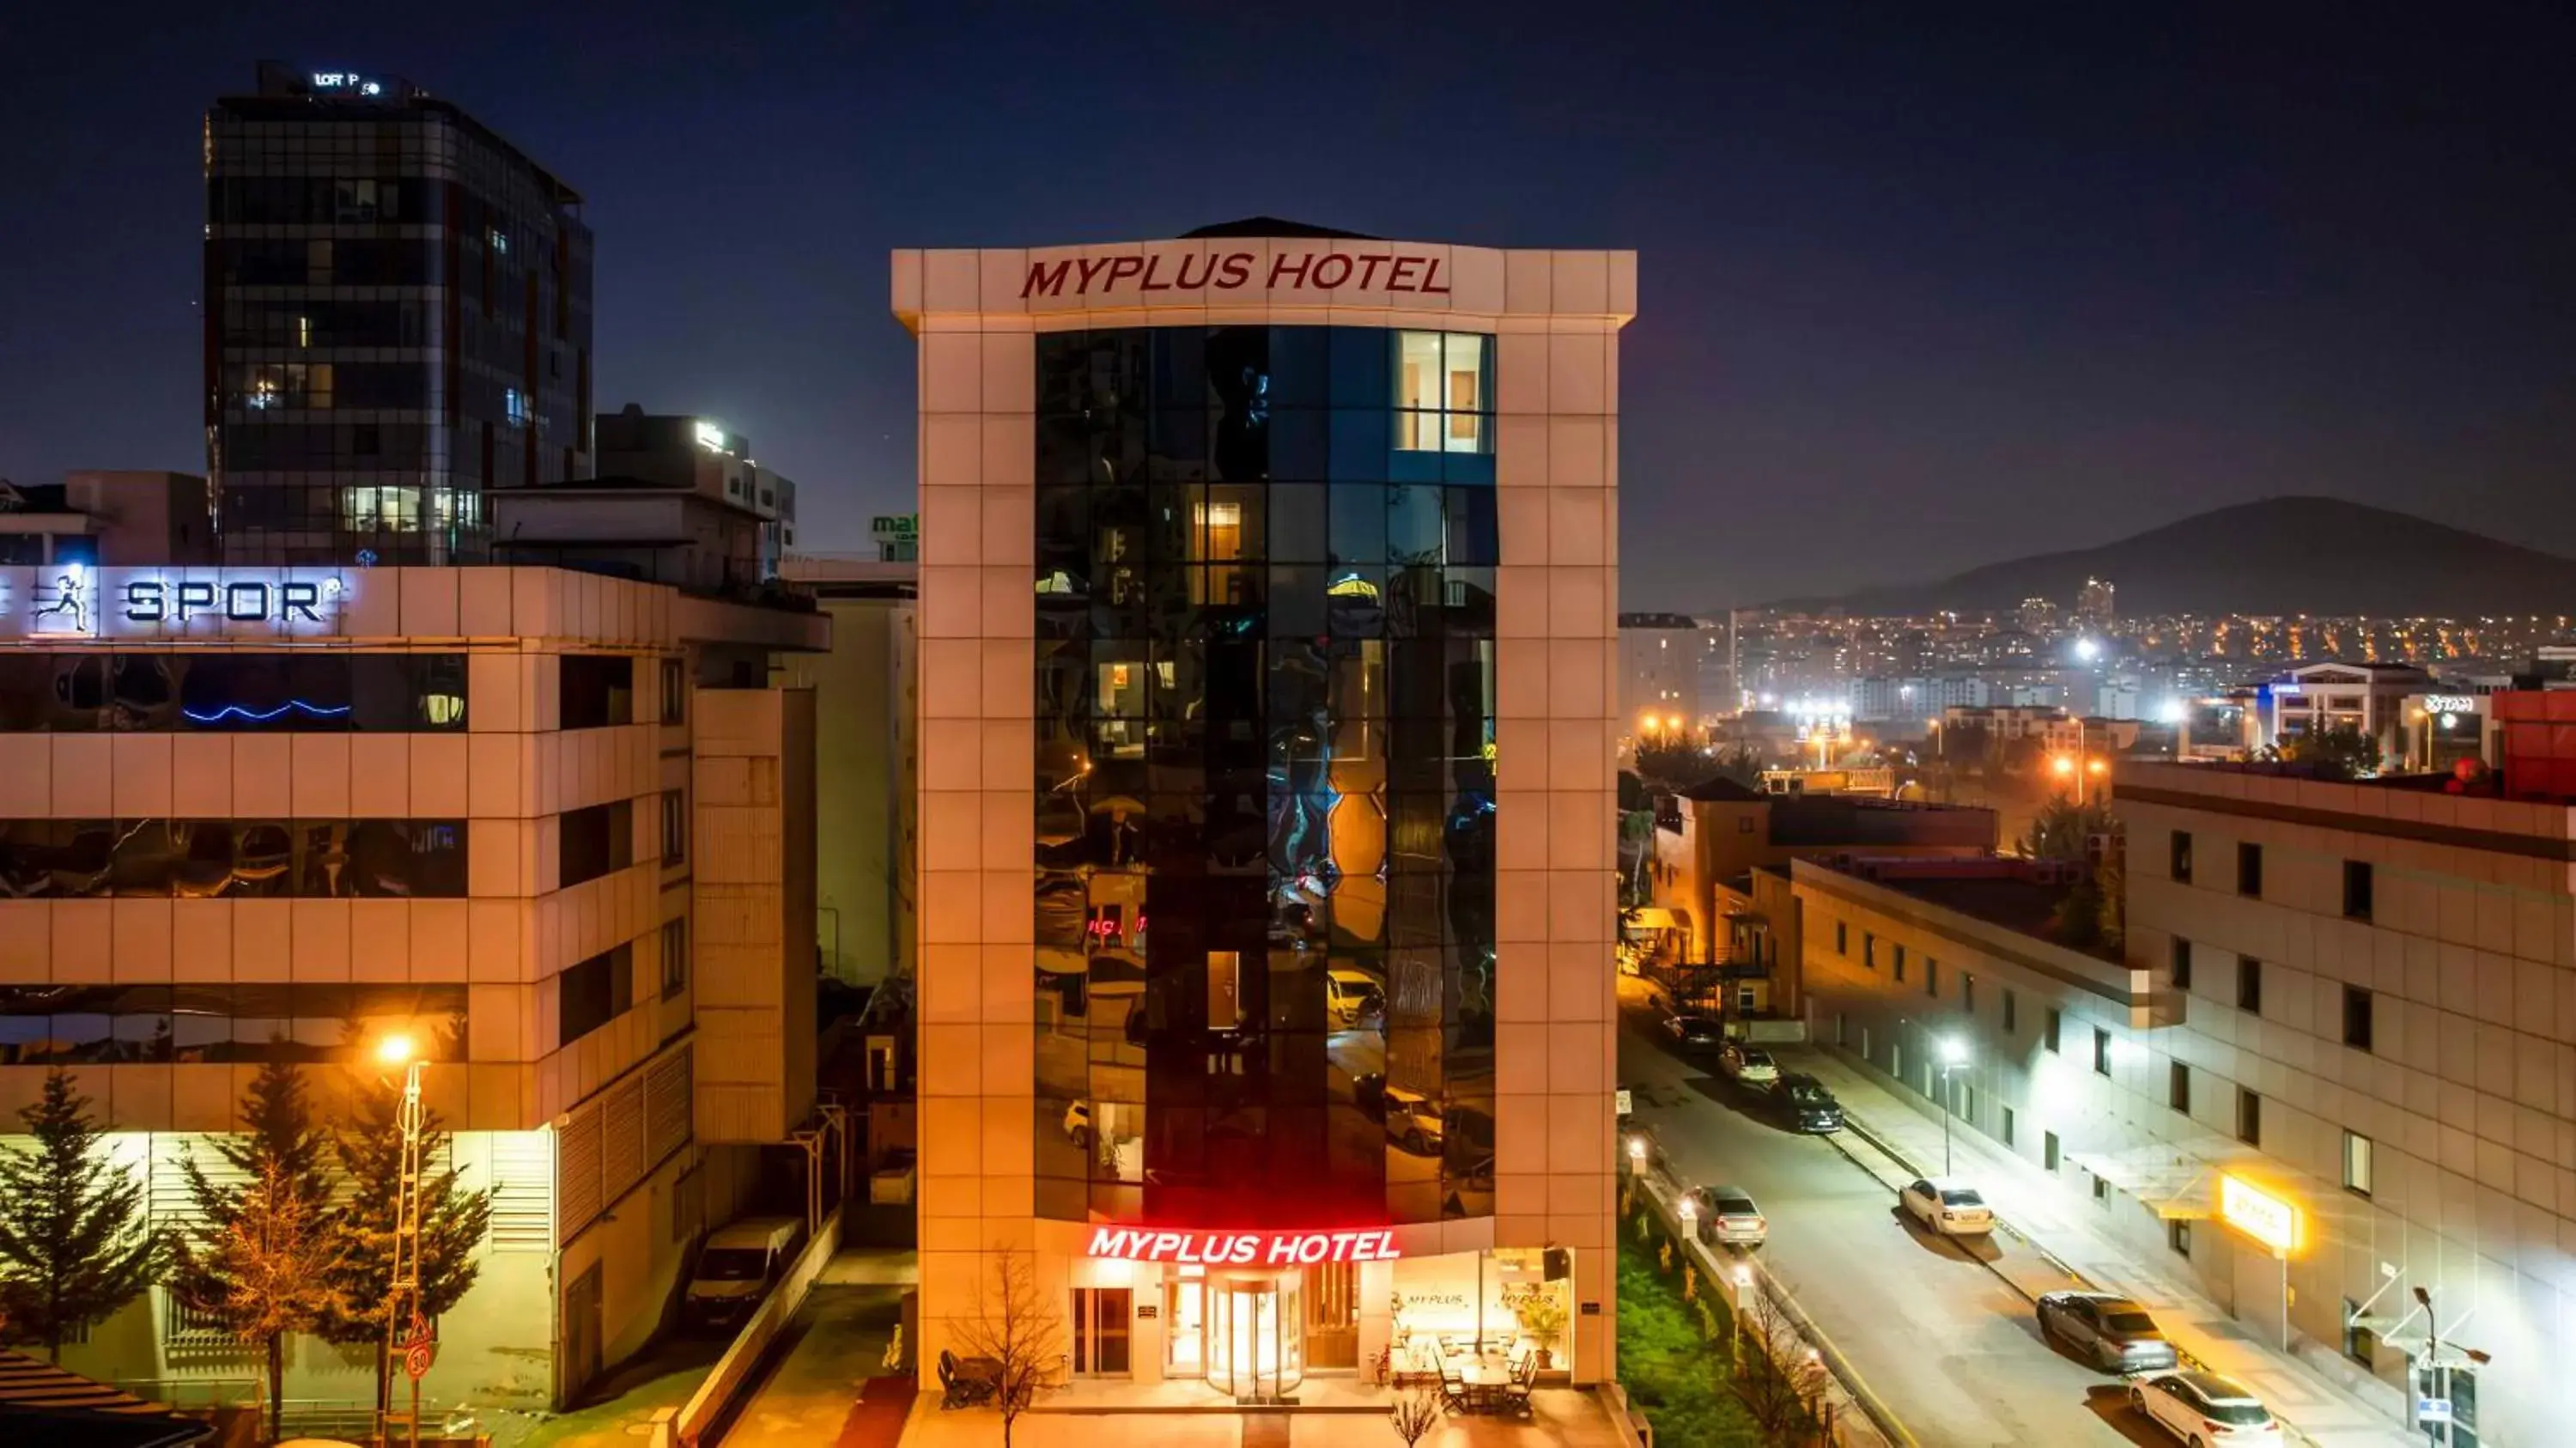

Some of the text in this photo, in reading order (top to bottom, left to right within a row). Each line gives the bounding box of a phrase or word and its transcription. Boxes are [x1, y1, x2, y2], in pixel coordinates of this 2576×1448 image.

[314, 74, 343, 86] LOFT
[1018, 252, 1452, 298] MYPLUS HOTEL
[126, 581, 325, 622] SPOR
[1088, 1227, 1401, 1263] MYPLUS HOTEL
